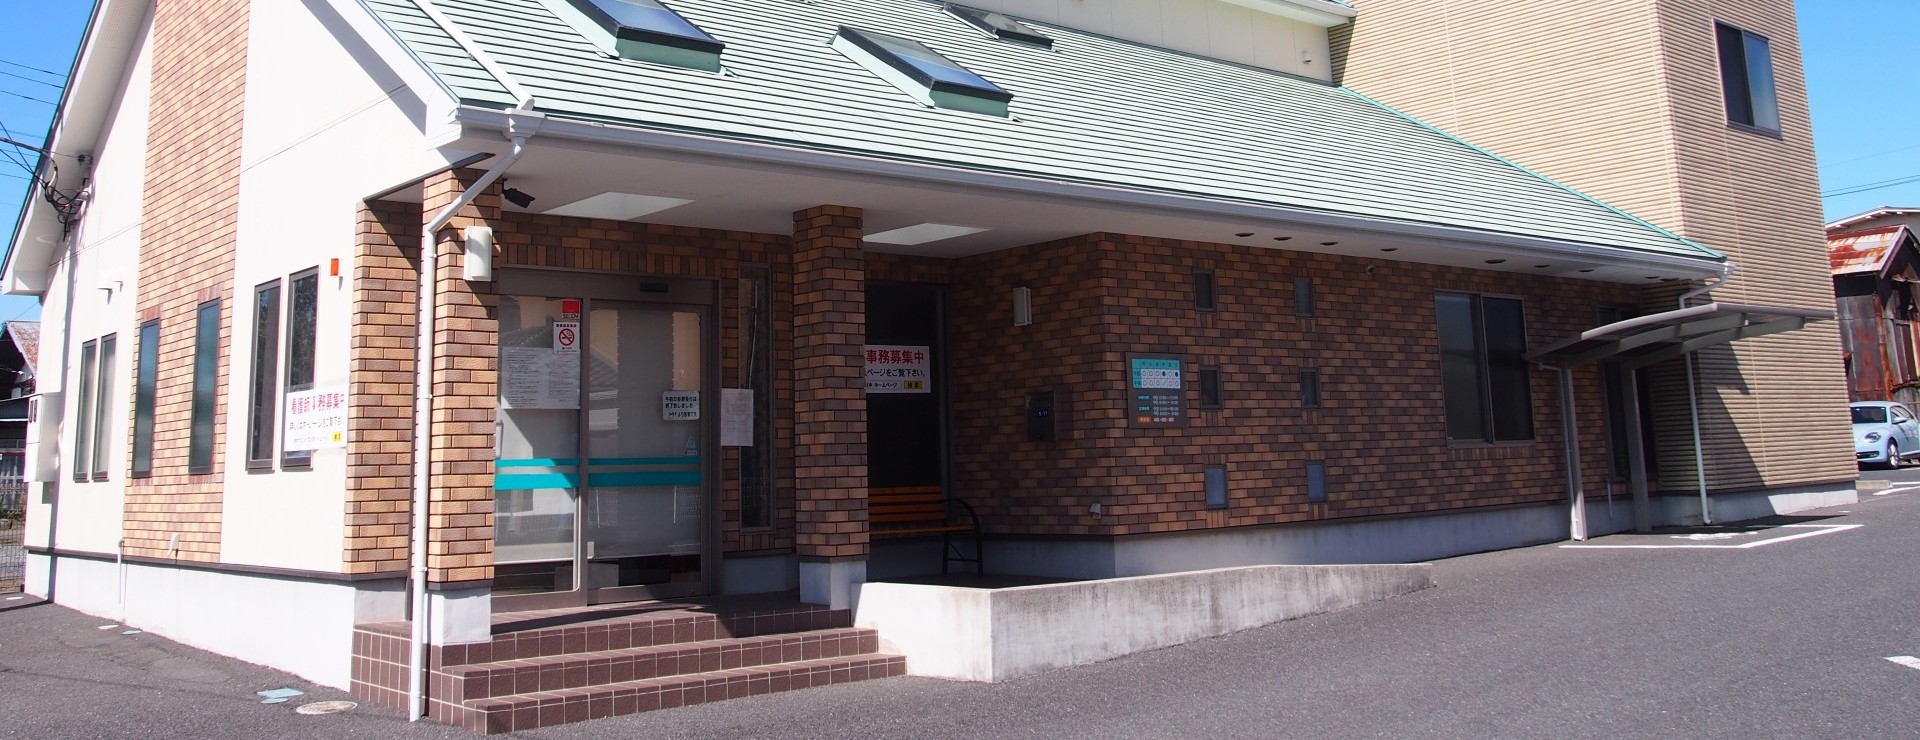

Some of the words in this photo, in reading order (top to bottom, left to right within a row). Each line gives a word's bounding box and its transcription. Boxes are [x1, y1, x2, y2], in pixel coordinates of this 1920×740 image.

[866, 349, 924, 364] 事務募集中
[865, 368, 925, 377] ページをご覧下さい。
